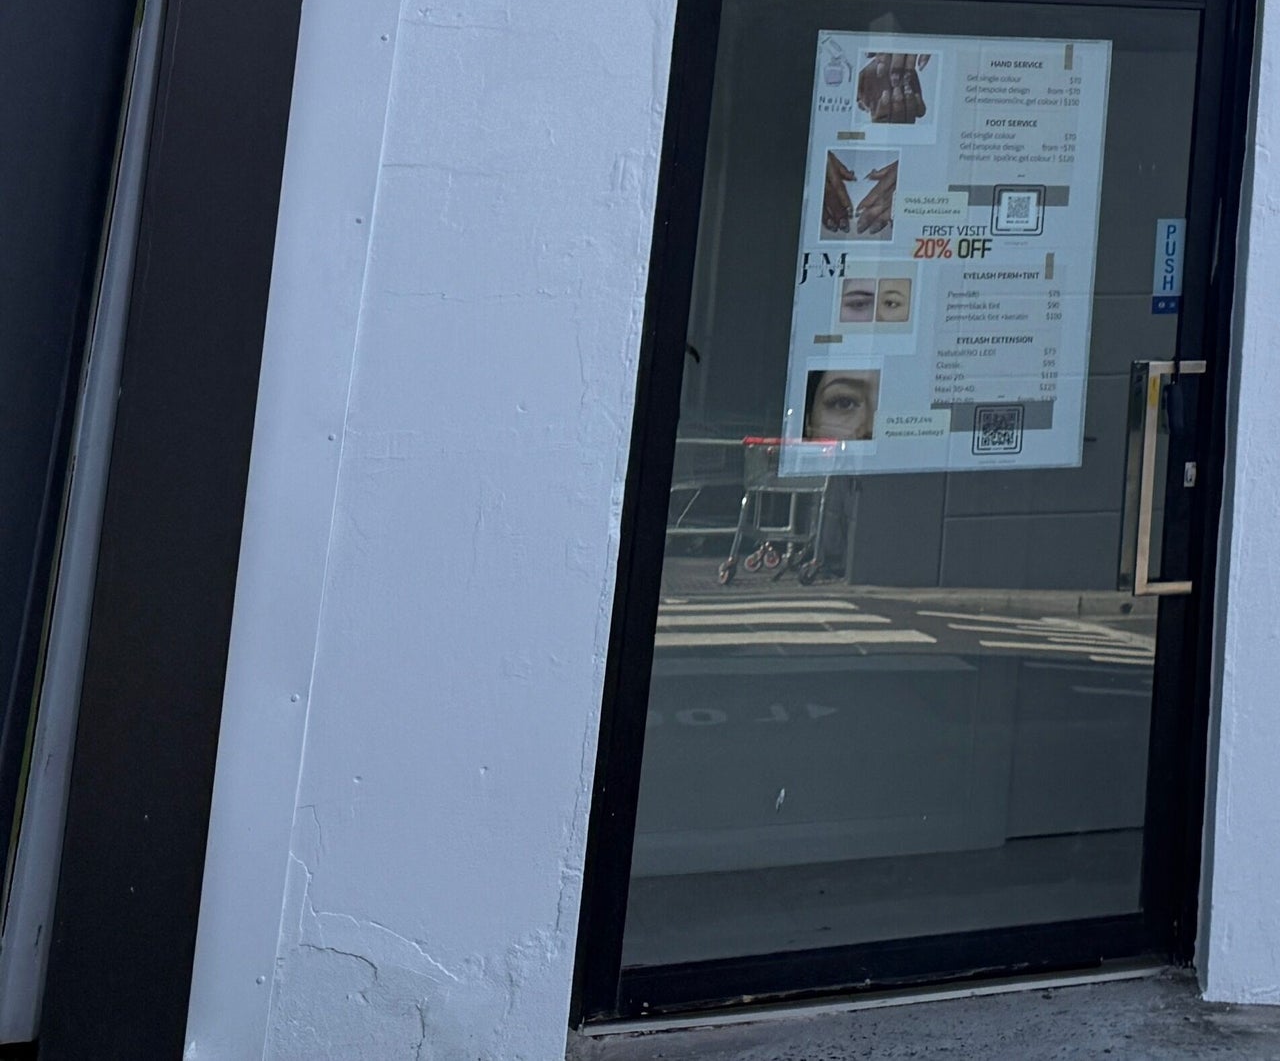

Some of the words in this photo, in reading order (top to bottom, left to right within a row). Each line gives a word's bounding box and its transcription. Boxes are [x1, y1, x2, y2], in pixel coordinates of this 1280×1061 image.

[990, 60, 1012, 68] HAND
[1013, 61, 1044, 69] SERVICE
[985, 119, 1006, 127] FOOT
[1007, 119, 1038, 127] SERVICE
[922, 225, 953, 236] FIRST
[956, 225, 988, 236] VISIT
[913, 238, 953, 259] 20%
[957, 238, 993, 259] OFF
[1162, 224, 1177, 290] PUSH
[963, 272, 996, 280] EYELASH
[956, 336, 990, 345] EYELASH
[991, 336, 1034, 344] EXTENSION
